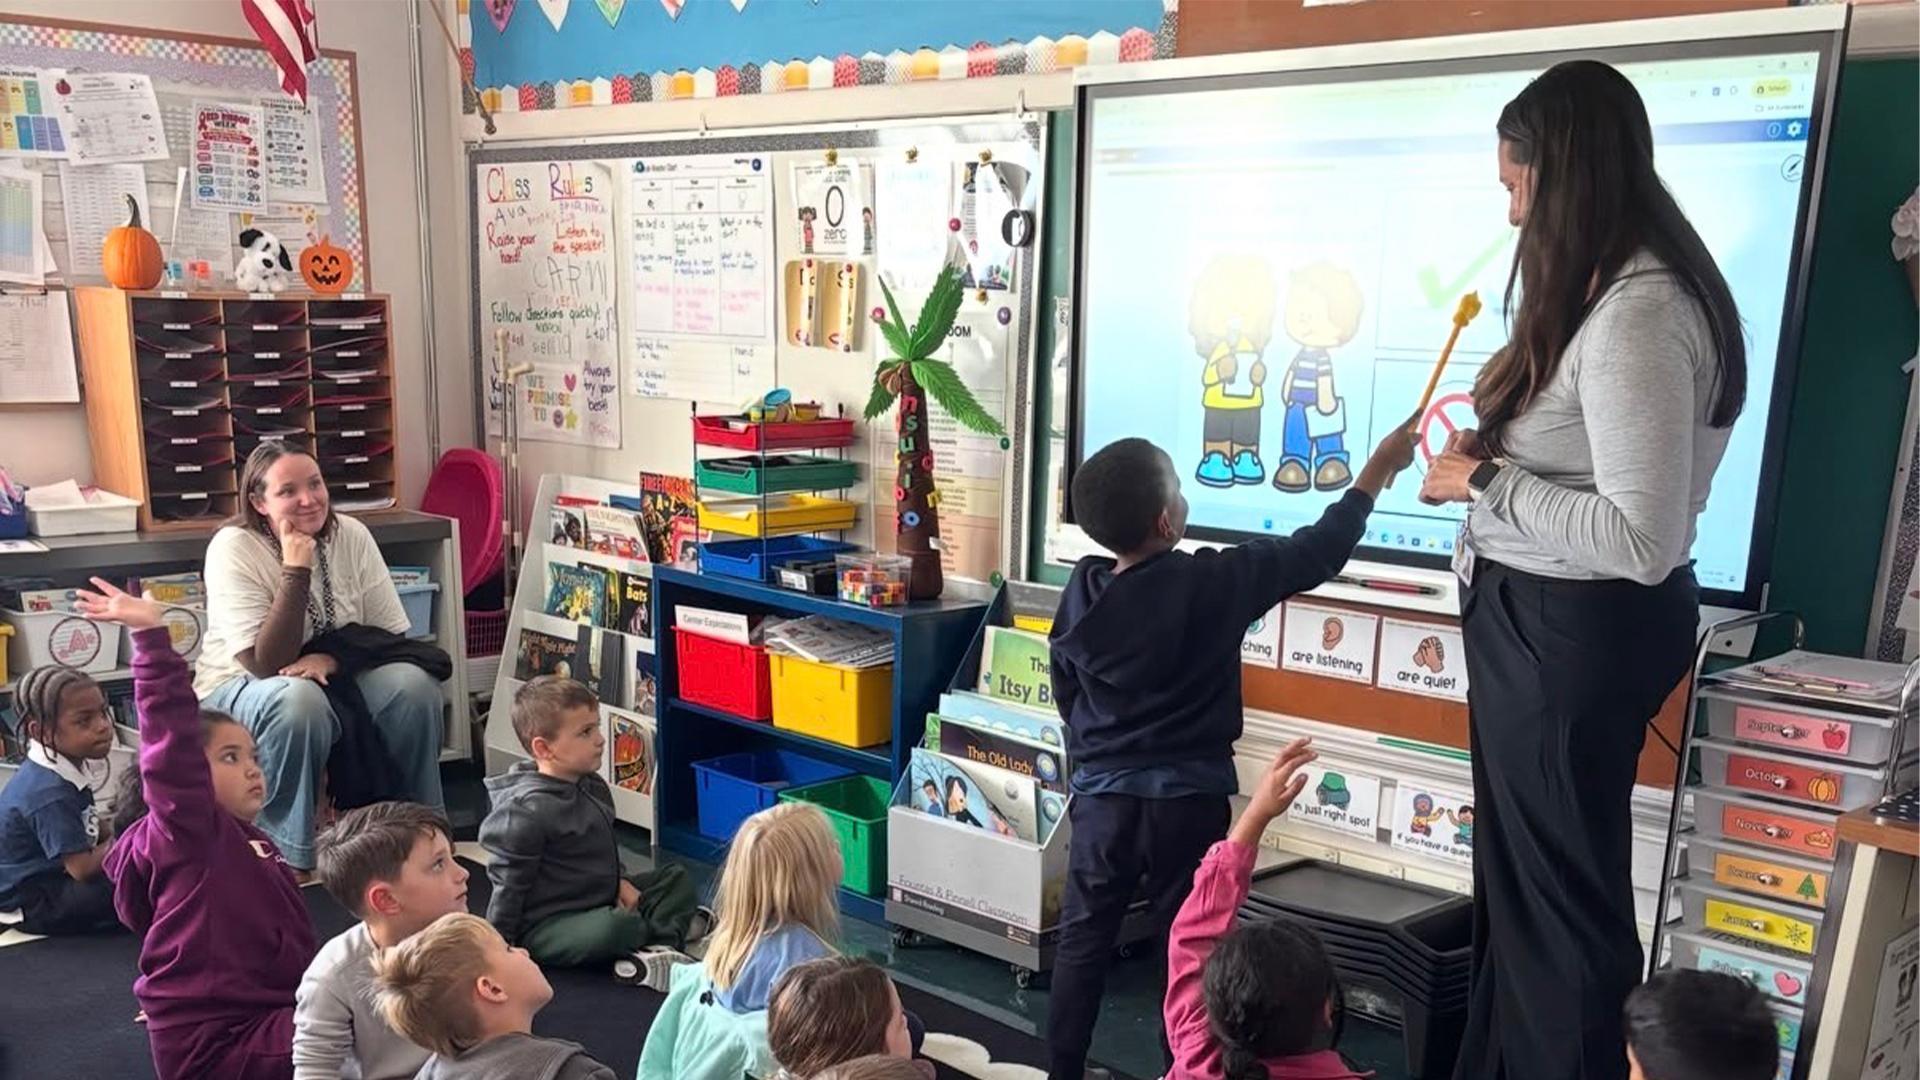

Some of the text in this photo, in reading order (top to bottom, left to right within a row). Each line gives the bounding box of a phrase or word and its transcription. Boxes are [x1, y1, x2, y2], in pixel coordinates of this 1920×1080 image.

[487, 162, 593, 202] Clss Ruls
[627, 586, 647, 602] Bats
[1243, 641, 1272, 656] ching
[1030, 656, 1050, 674] The
[1292, 651, 1363, 676] are listening
[1000, 674, 1032, 704] Itsy
[1397, 670, 1456, 690] are quiet
[967, 745, 1034, 776] The Old Lady
[1304, 802, 1321, 818] just
[1323, 807, 1347, 823] right
[1349, 813, 1371, 828] spot
